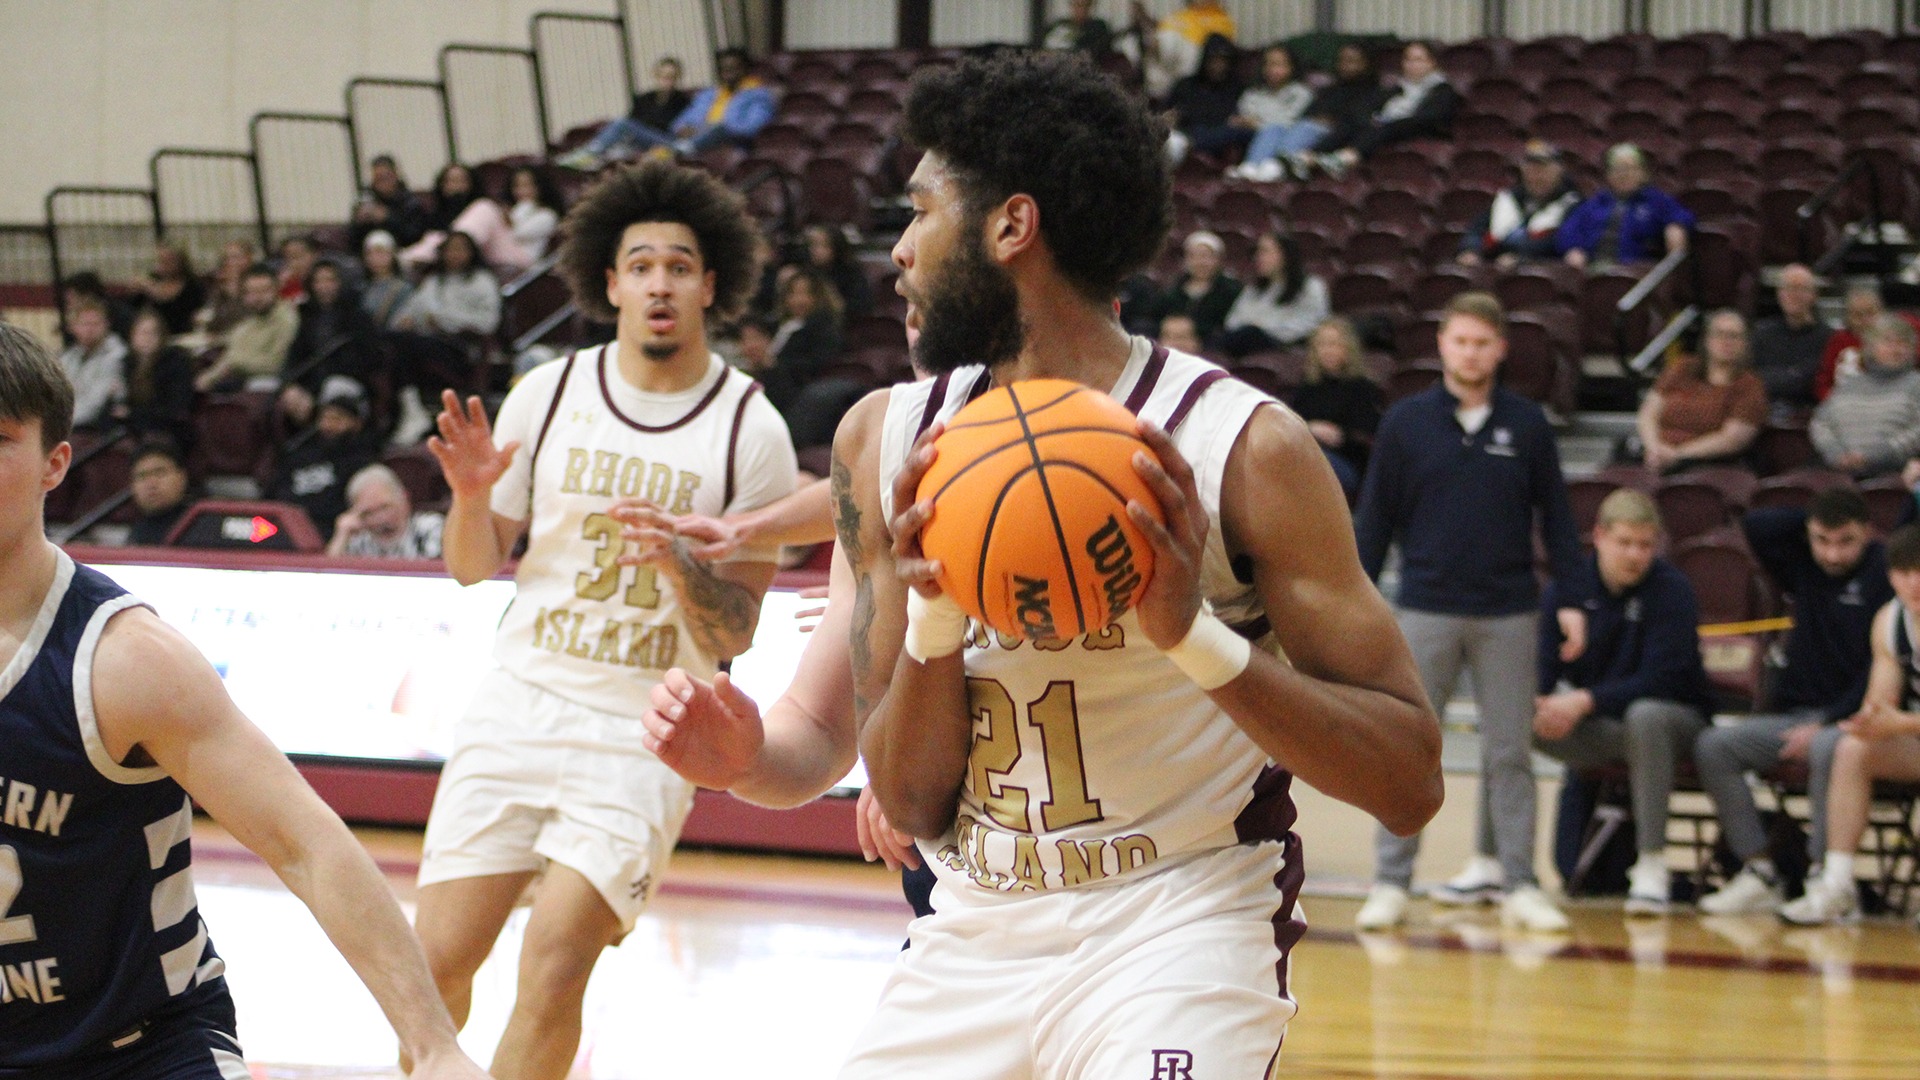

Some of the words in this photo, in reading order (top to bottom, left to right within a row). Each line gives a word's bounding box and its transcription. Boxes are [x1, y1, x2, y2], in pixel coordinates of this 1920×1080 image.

[560, 447, 701, 515] RHODE
[532, 607, 680, 670] ISLAND
[965, 675, 1105, 832] 21
[0, 776, 75, 837] RN
